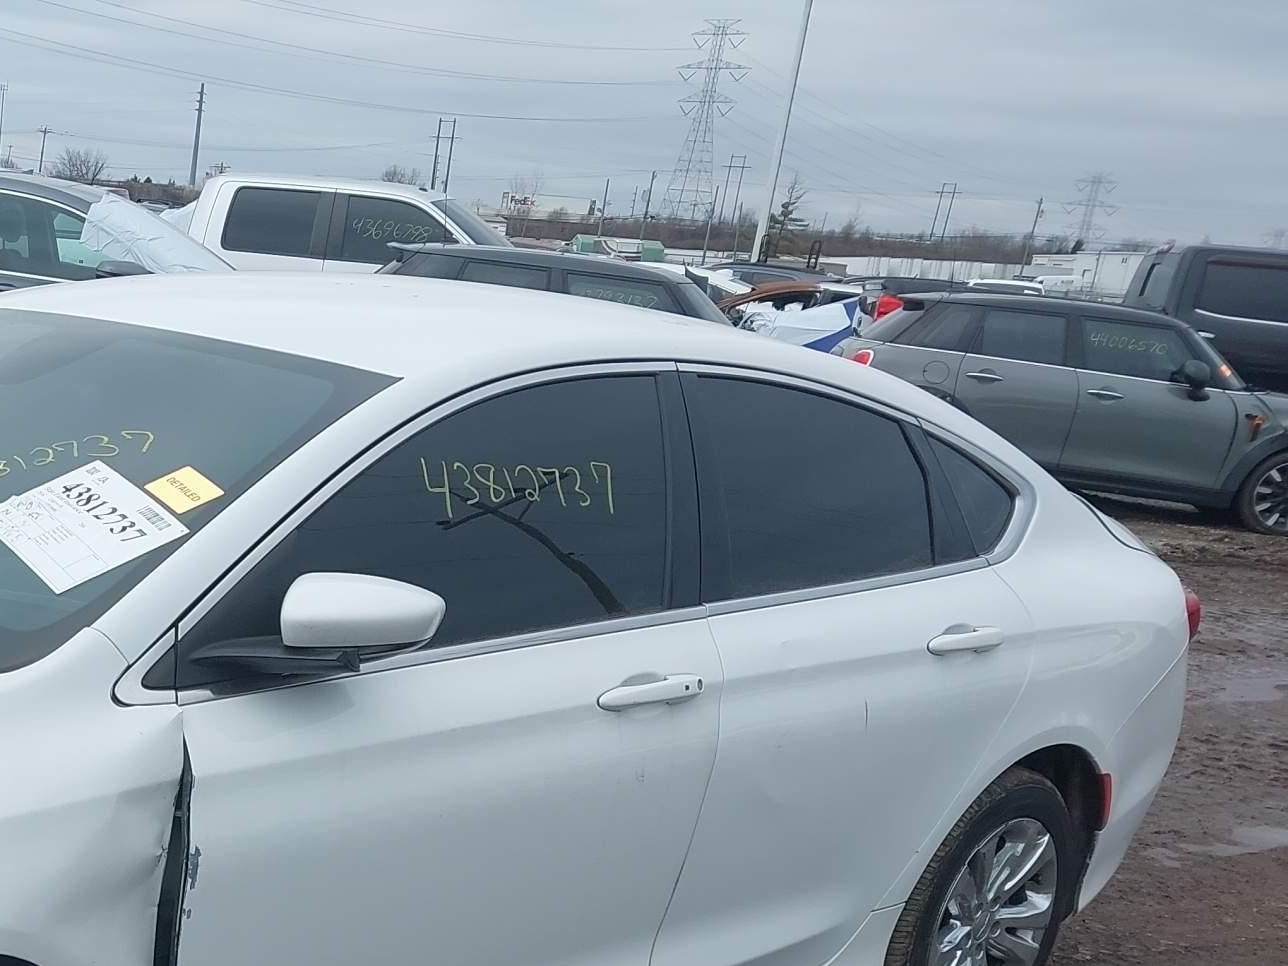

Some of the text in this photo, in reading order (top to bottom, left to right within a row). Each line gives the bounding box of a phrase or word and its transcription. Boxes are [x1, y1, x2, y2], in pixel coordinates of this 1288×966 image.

[510, 195, 536, 206] FedEx
[166, 476, 201, 503] DETAILED
[419, 457, 614, 518] 43812737
[62, 482, 148, 542] 43812737
